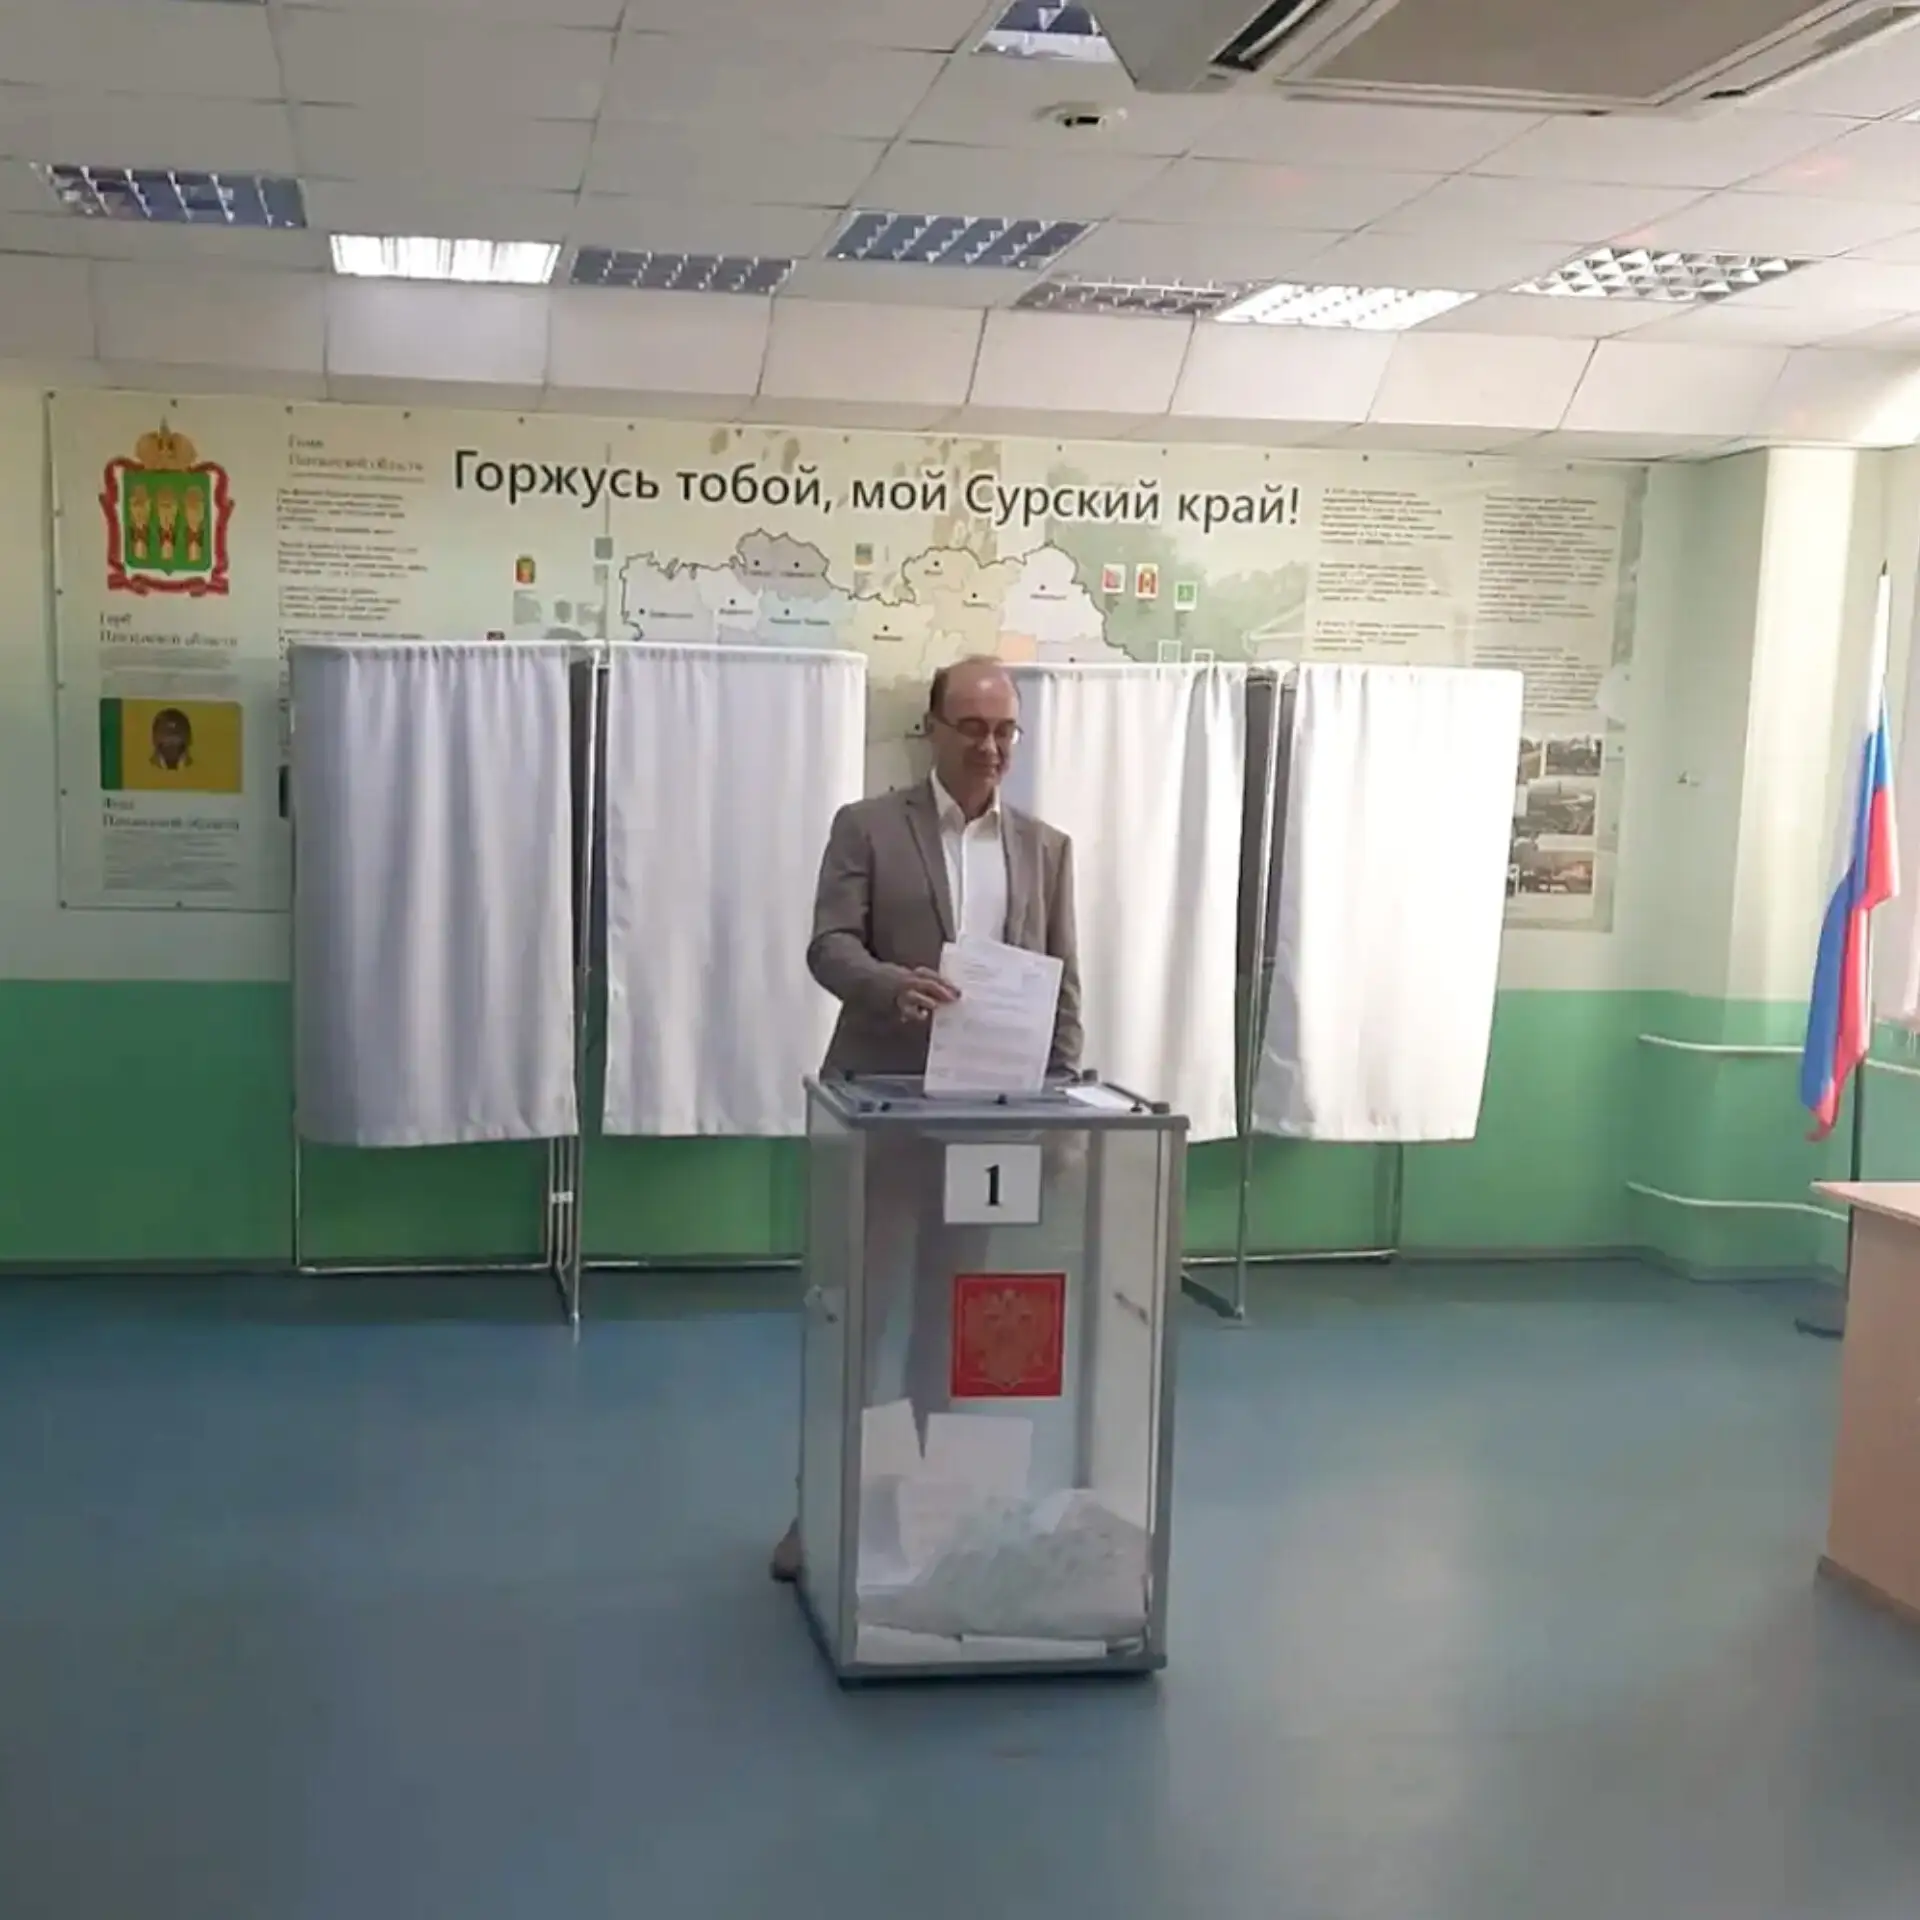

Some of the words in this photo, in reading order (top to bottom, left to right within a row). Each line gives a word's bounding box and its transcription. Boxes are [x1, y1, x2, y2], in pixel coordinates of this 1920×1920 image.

[454, 450, 660, 508] Горжусь
[676, 462, 833, 514] тобой,
[852, 469, 946, 511] мой
[965, 472, 1160, 526] Сурский
[1177, 483, 1300, 534] край!
[984, 1164, 1003, 1207] 1
